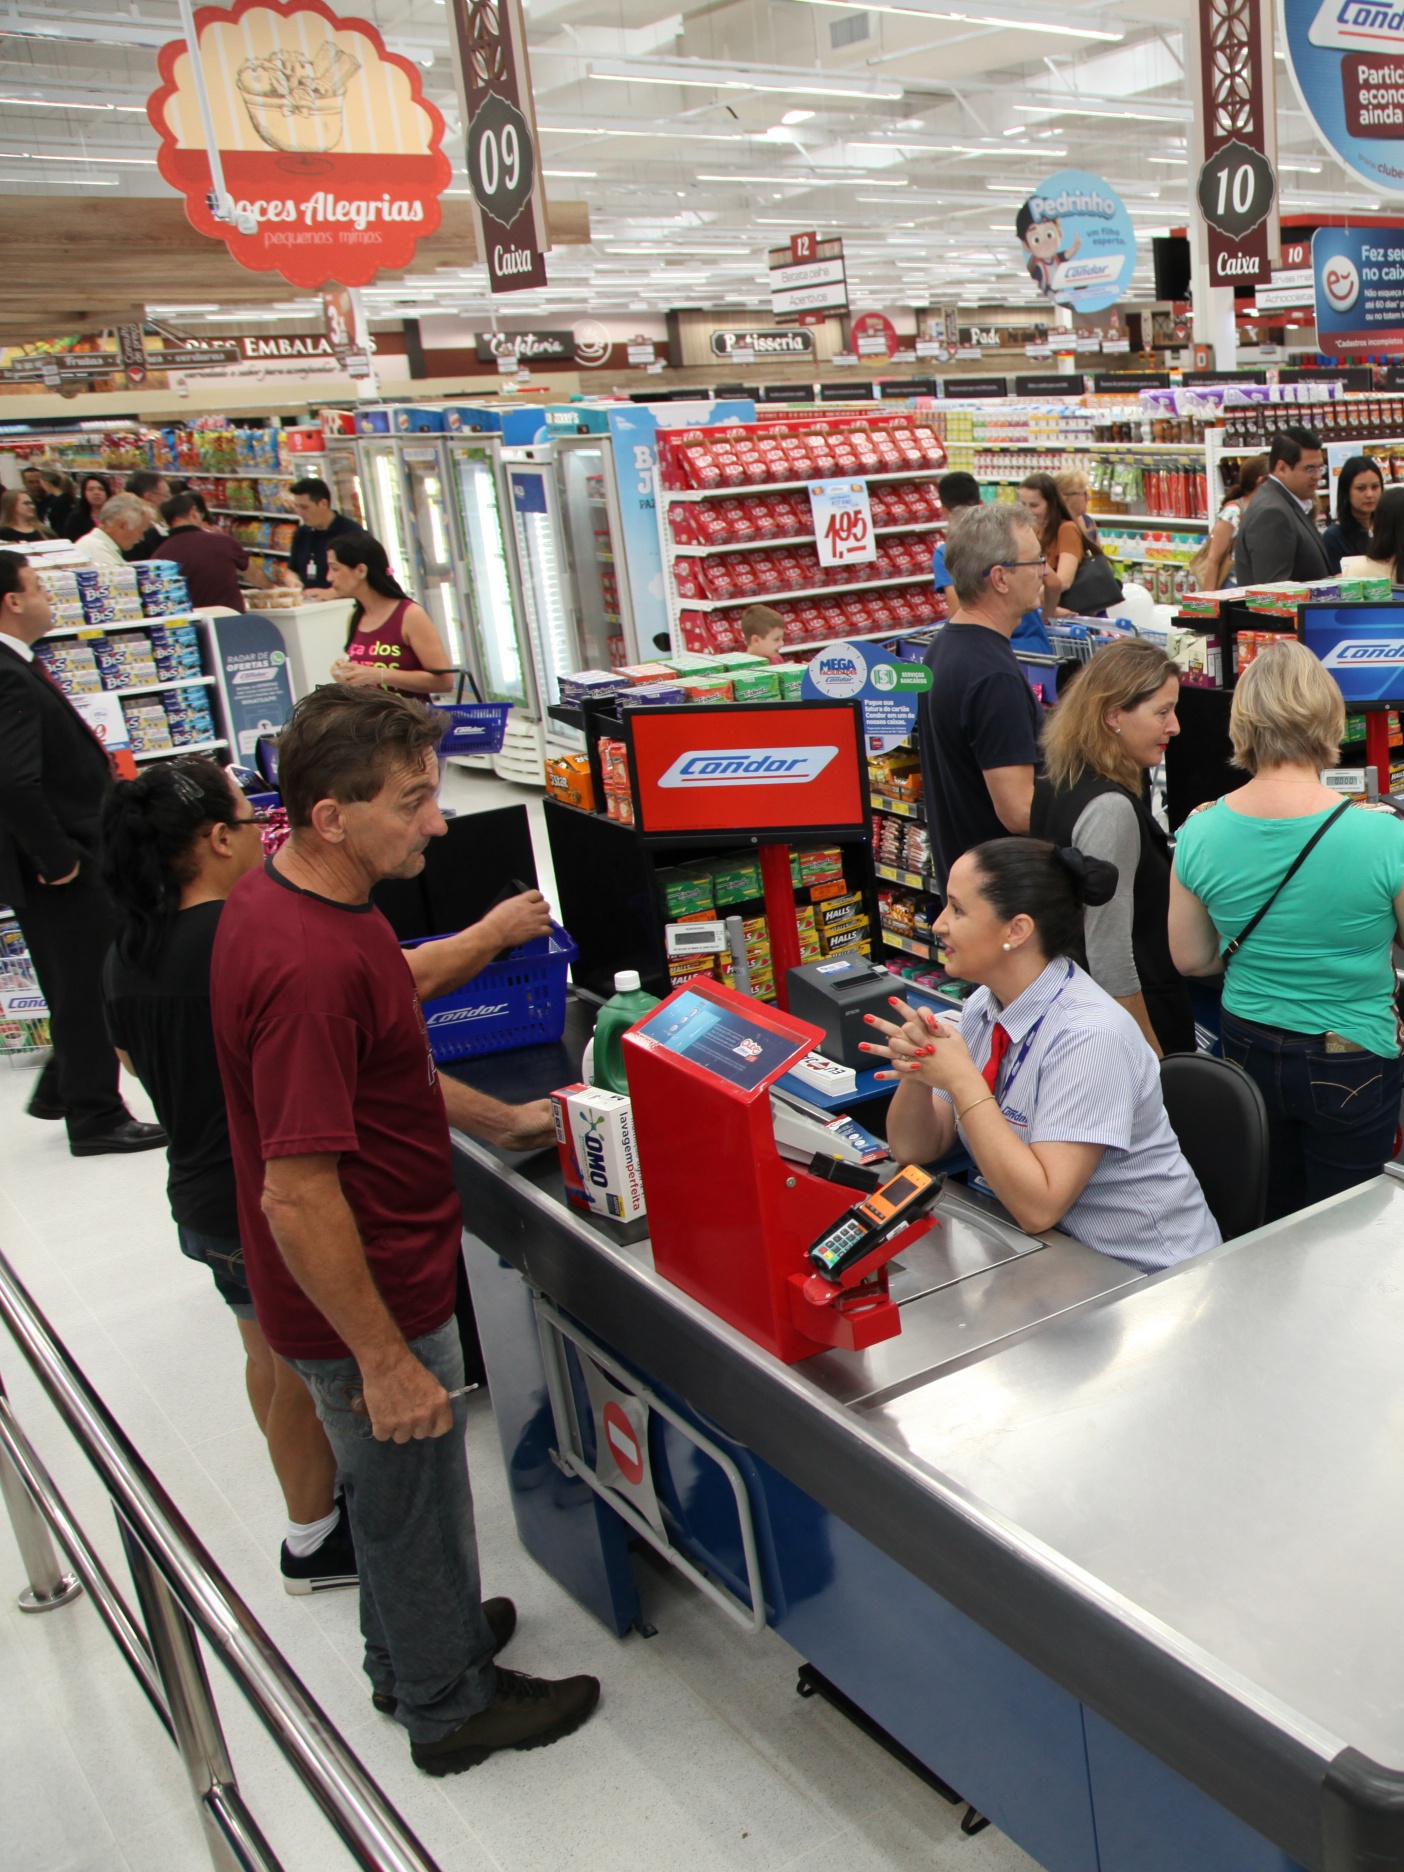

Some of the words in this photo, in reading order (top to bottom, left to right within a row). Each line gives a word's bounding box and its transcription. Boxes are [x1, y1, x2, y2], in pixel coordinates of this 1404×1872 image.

[1359, 106, 1403, 125] ainda
[480, 124, 520, 195] 09
[1217, 164, 1255, 215] 10
[214, 192, 297, 222] oces
[300, 191, 424, 231] Alegrias
[1032, 190, 1115, 220] Pedrinho
[264, 231, 333, 248] pequenos
[339, 230, 382, 244] mimos
[797, 236, 810, 256] 12
[494, 244, 532, 276] Caixa
[1288, 246, 1303, 263] 10
[1361, 246, 1384, 262] Fez
[1217, 251, 1259, 275] Caixa
[782, 268, 809, 283] Batata
[811, 265, 830, 281] palha
[1362, 268, 1379, 281] no
[1364, 288, 1377, 297] Não
[1378, 290, 1401, 299] esqueça
[1383, 311, 1401, 320] totem
[724, 333, 803, 352] Pisseria
[1368, 337, 1403, 346] incompletos
[85, 585, 109, 601] BiS
[90, 607, 114, 623] BiS
[368, 641, 401, 656] dos
[102, 651, 125, 667] BiS
[227, 654, 256, 664] RADAR
[258, 652, 269, 661] DE
[820, 659, 857, 671] MEGA
[226, 661, 269, 672] OFERTAS
[106, 673, 129, 689] BiS
[591, 685, 617, 697] Trident
[743, 687, 767, 697] Trident
[679, 755, 809, 775] Condor
[826, 906, 850, 919] HALLS
[830, 931, 857, 945] HALLS
[427, 1003, 508, 1025] Condor
[845, 1008, 860, 1016] EPSON
[585, 1134, 608, 1188] OMO
